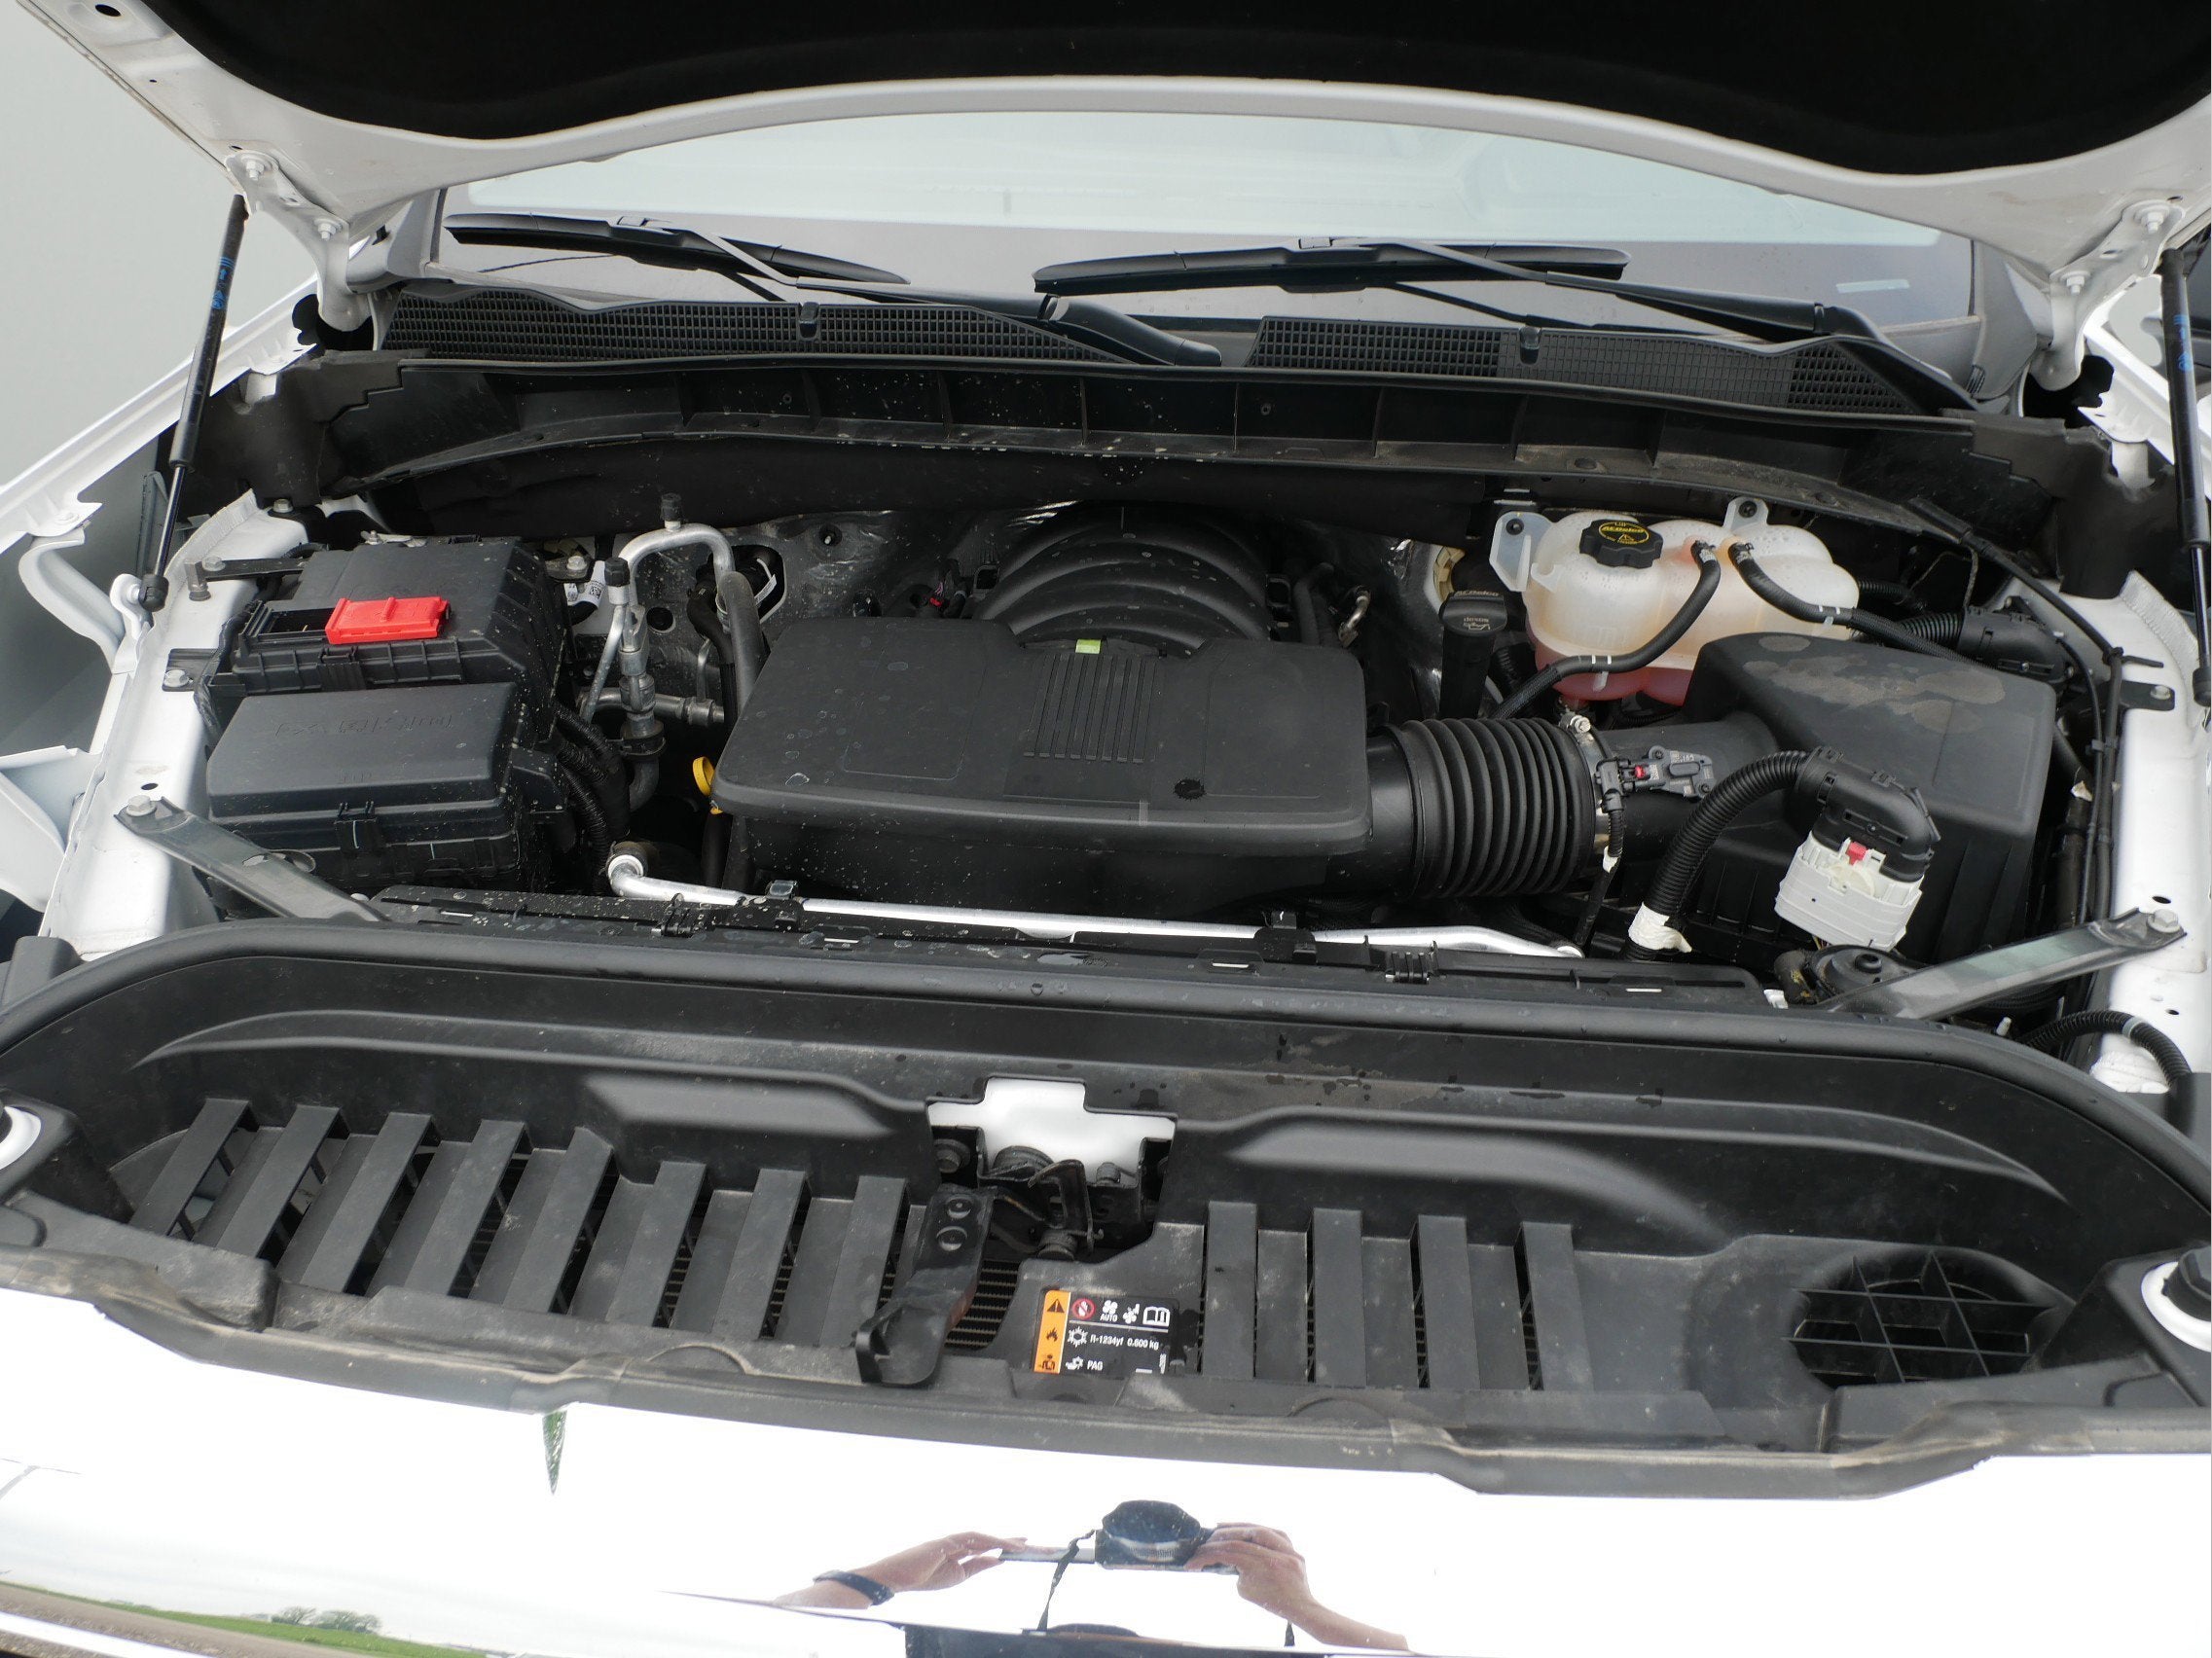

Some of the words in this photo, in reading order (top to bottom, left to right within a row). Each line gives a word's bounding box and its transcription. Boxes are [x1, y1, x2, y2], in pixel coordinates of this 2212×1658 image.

[1100, 1314, 1118, 1322] AUTO
[1090, 1334, 1124, 1347] R-1234yf
[1149, 1339, 1159, 1351] kg
[1087, 1360, 1104, 1371] PAG
